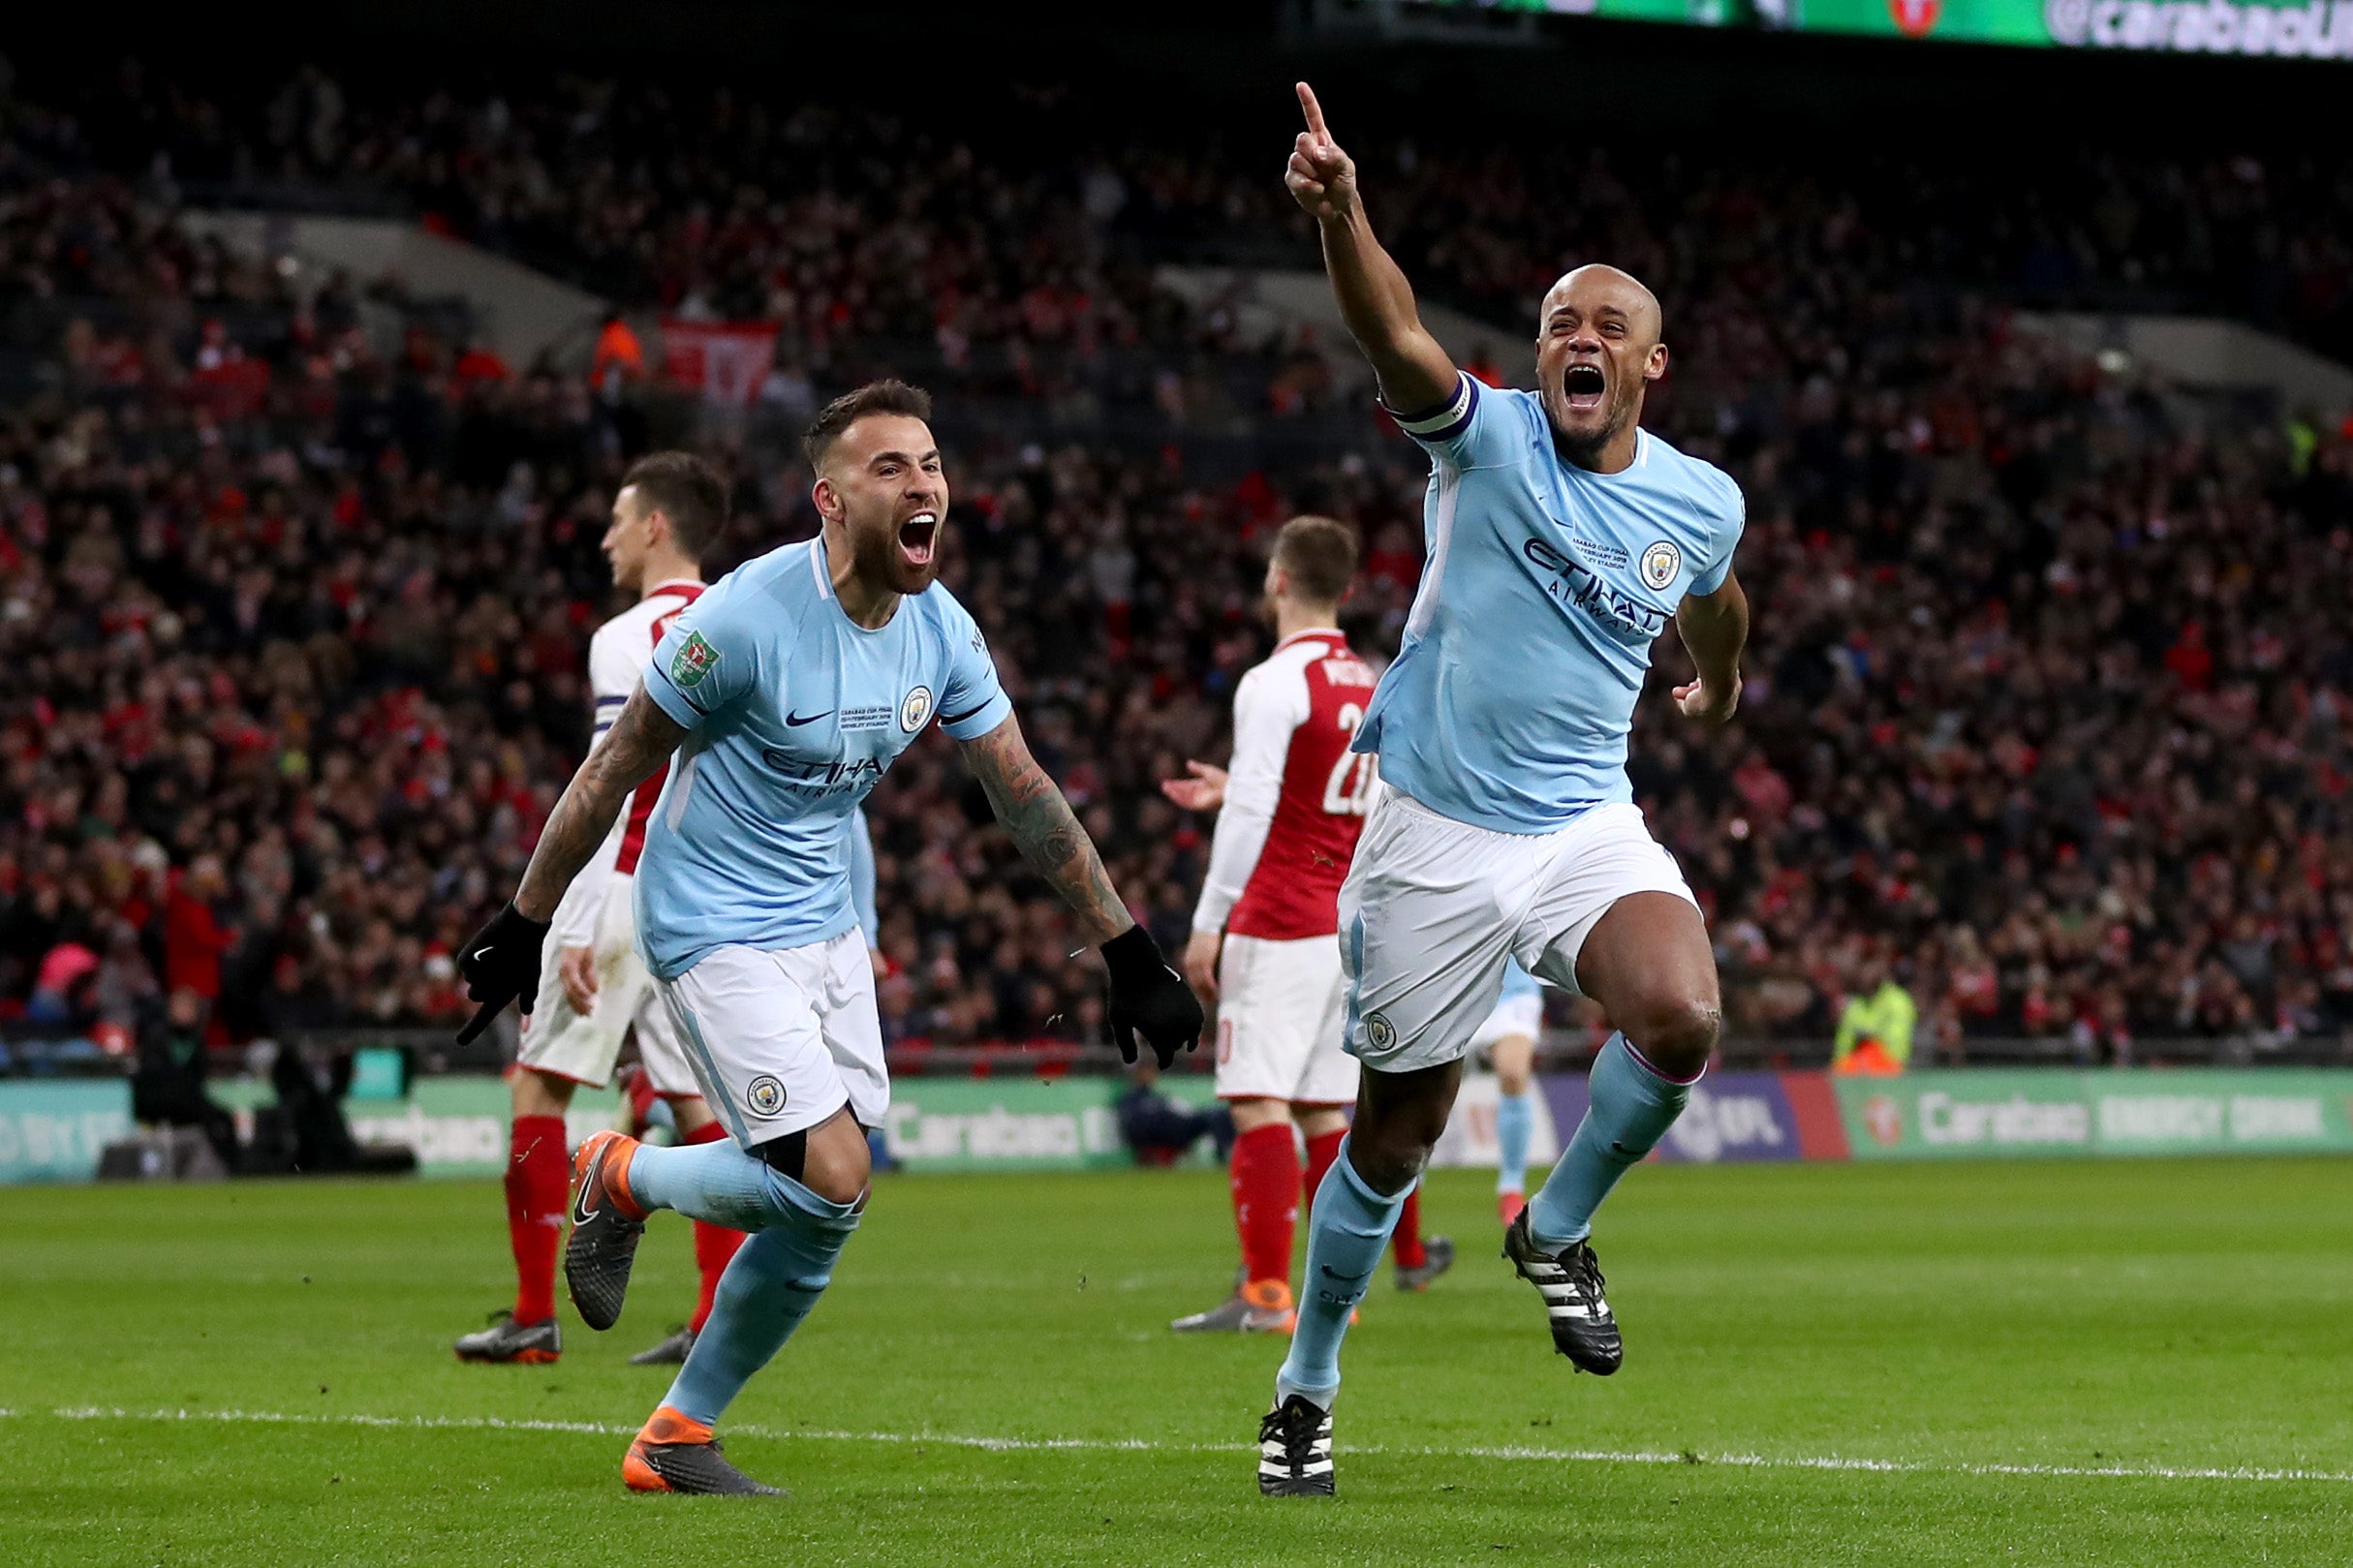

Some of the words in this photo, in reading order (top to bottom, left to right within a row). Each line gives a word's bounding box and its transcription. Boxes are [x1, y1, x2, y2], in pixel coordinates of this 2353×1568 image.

[1573, 538, 1596, 549] ARABAO
[762, 748, 897, 784] ETIHA
[785, 779, 874, 798] AIRWAY
[885, 1102, 1079, 1157] Carabao
[1918, 1091, 2089, 1144] Carabao
[2100, 1094, 2222, 1138] ENERGY
